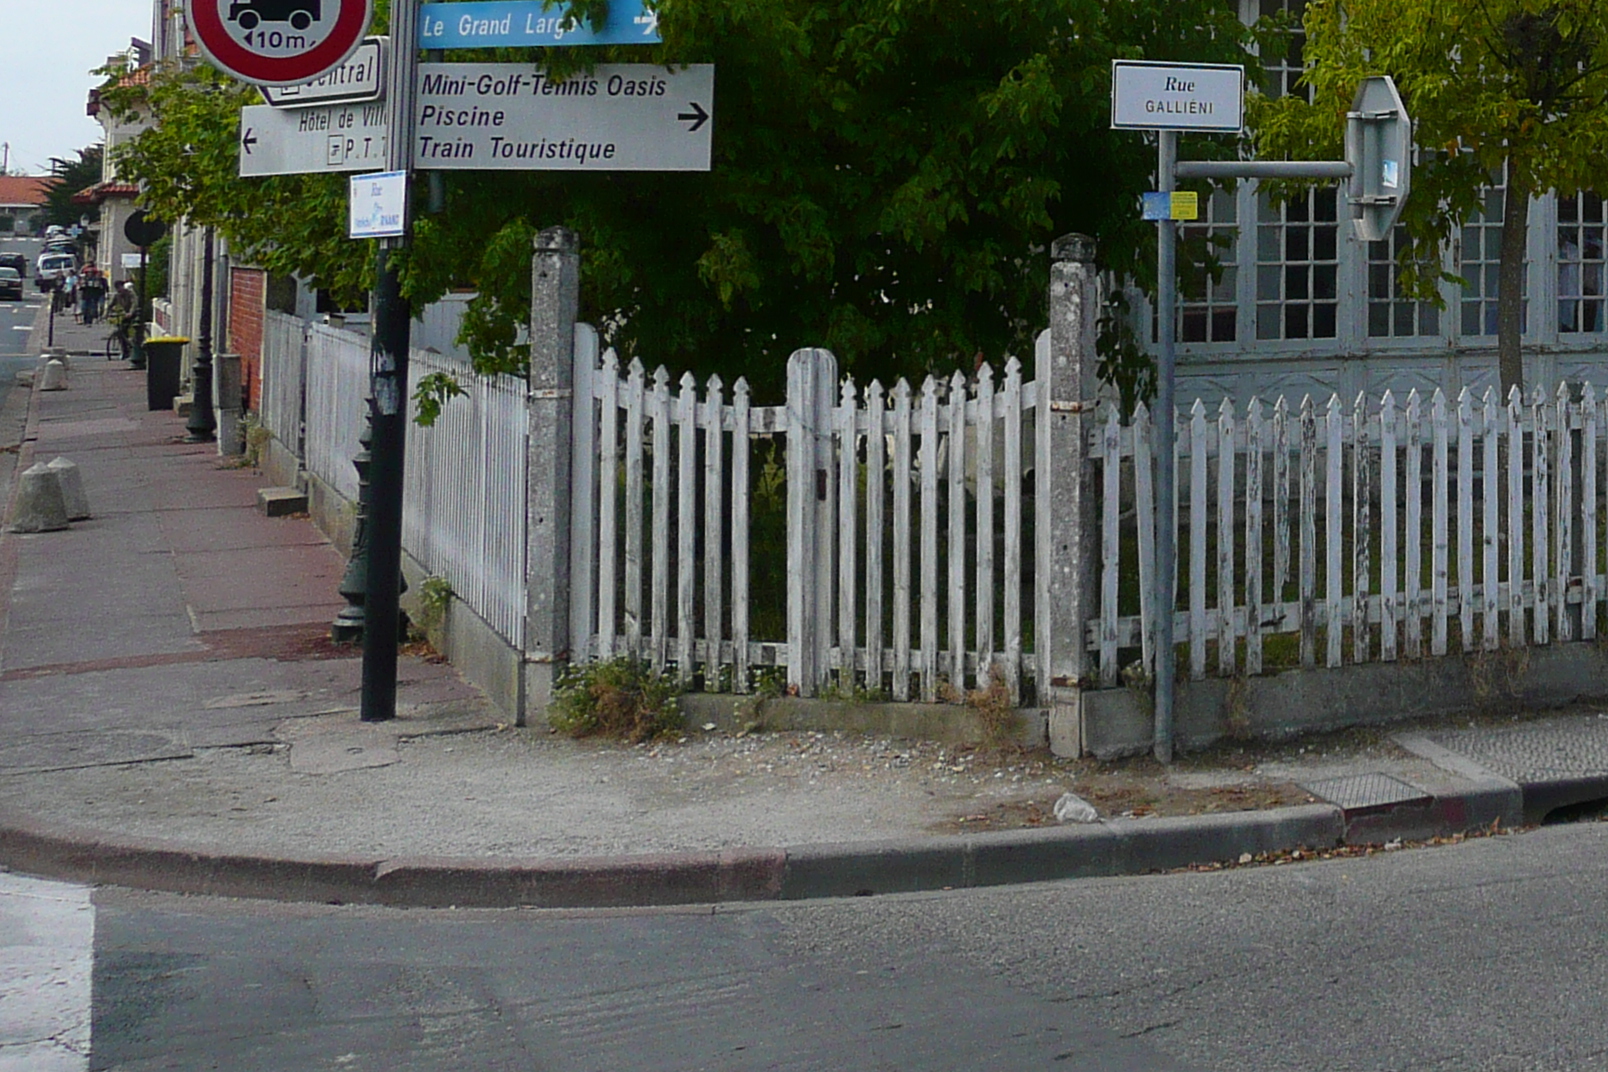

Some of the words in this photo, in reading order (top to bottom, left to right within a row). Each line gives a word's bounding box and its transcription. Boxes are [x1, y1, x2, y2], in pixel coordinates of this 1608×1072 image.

[423, 15, 443, 37] Le
[459, 13, 511, 36] Grand
[306, 55, 373, 88] entral
[421, 73, 598, 96] Mini-Golf-Tennis
[606, 74, 667, 96] Oasis
[1164, 76, 1195, 92] Rue
[420, 105, 505, 127] Piscine
[1145, 98, 1213, 114] GALLIÉNI
[298, 109, 331, 132] Hôtel
[338, 108, 353, 129] de
[419, 136, 474, 158] Train
[490, 136, 616, 164] Touristique
